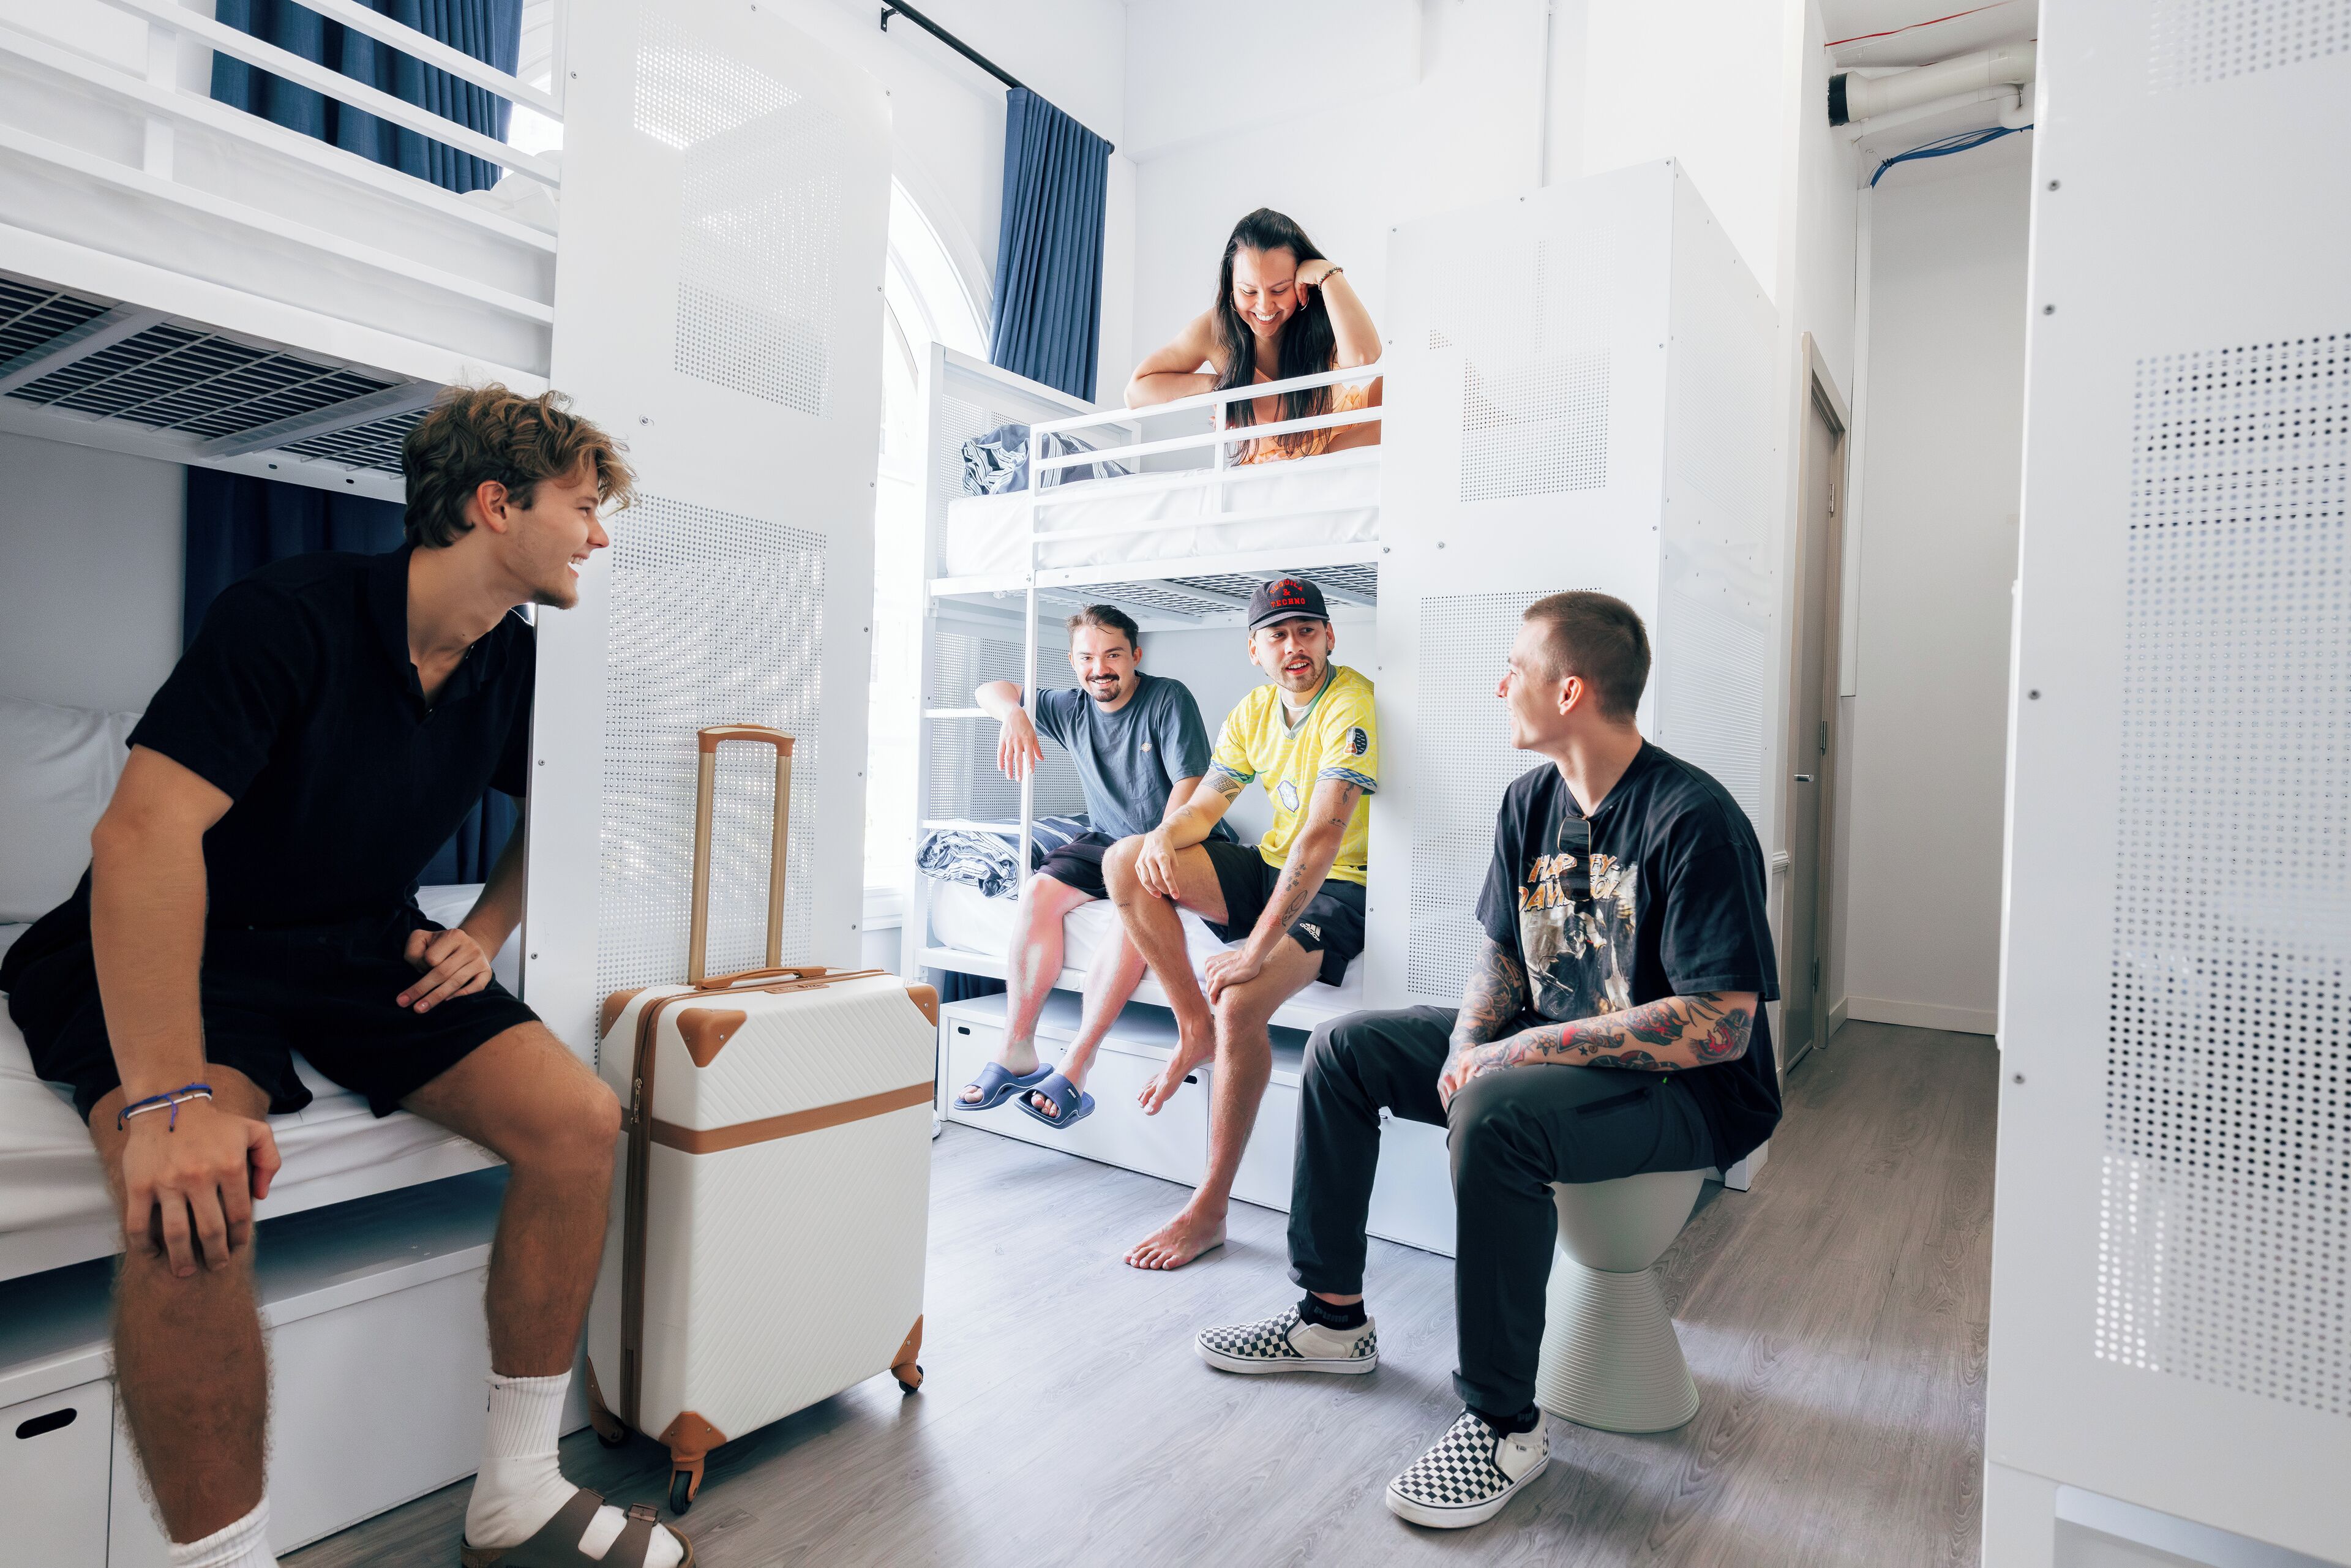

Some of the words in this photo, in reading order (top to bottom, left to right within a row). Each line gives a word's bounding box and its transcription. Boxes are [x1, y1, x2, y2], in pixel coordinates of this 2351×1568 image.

[1270, 579, 1303, 593] TEQUILA
[1270, 597, 1306, 607] TECHNO
[1528, 853, 1621, 883] HAREY-
[1299, 923, 1321, 942] adidas
